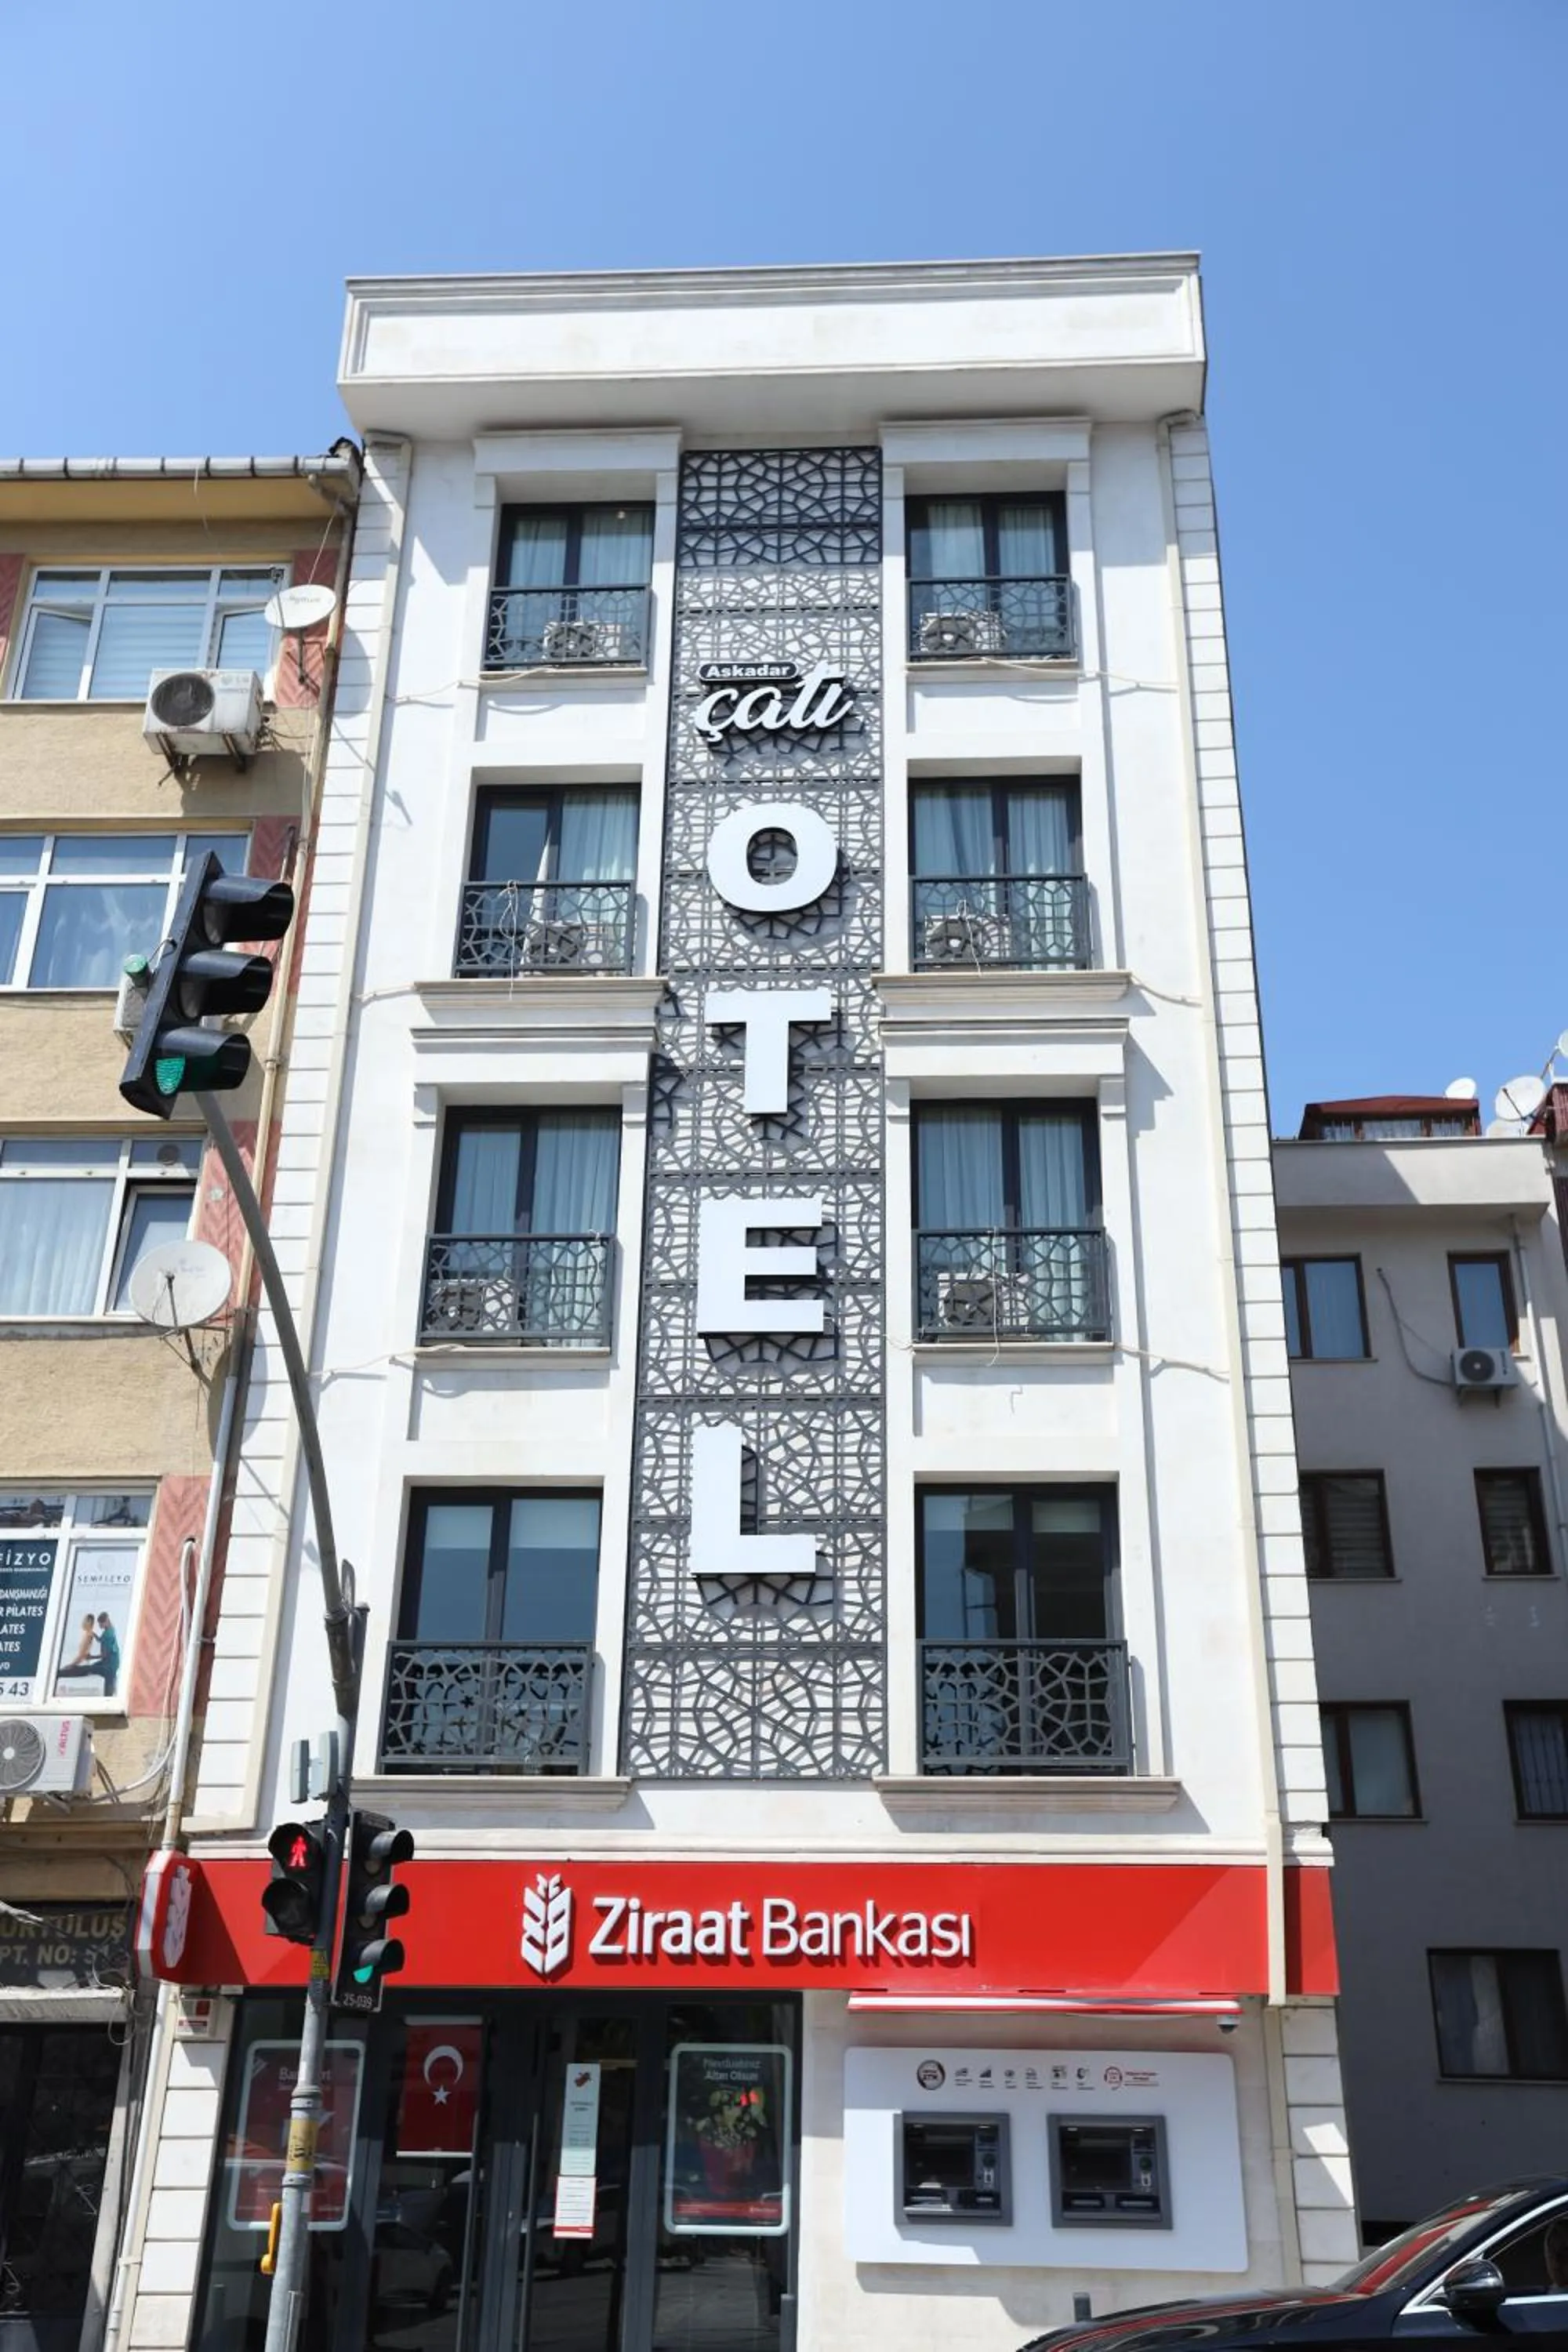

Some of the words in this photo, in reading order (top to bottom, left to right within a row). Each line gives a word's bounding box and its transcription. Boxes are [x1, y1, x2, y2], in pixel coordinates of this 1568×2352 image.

[706, 664, 789, 678] Askadar
[691, 801, 838, 1574] OTEL
[0, 1623, 26, 1635] ATES
[590, 1897, 749, 1955] Ziraat
[763, 1899, 969, 1956] Bankası
